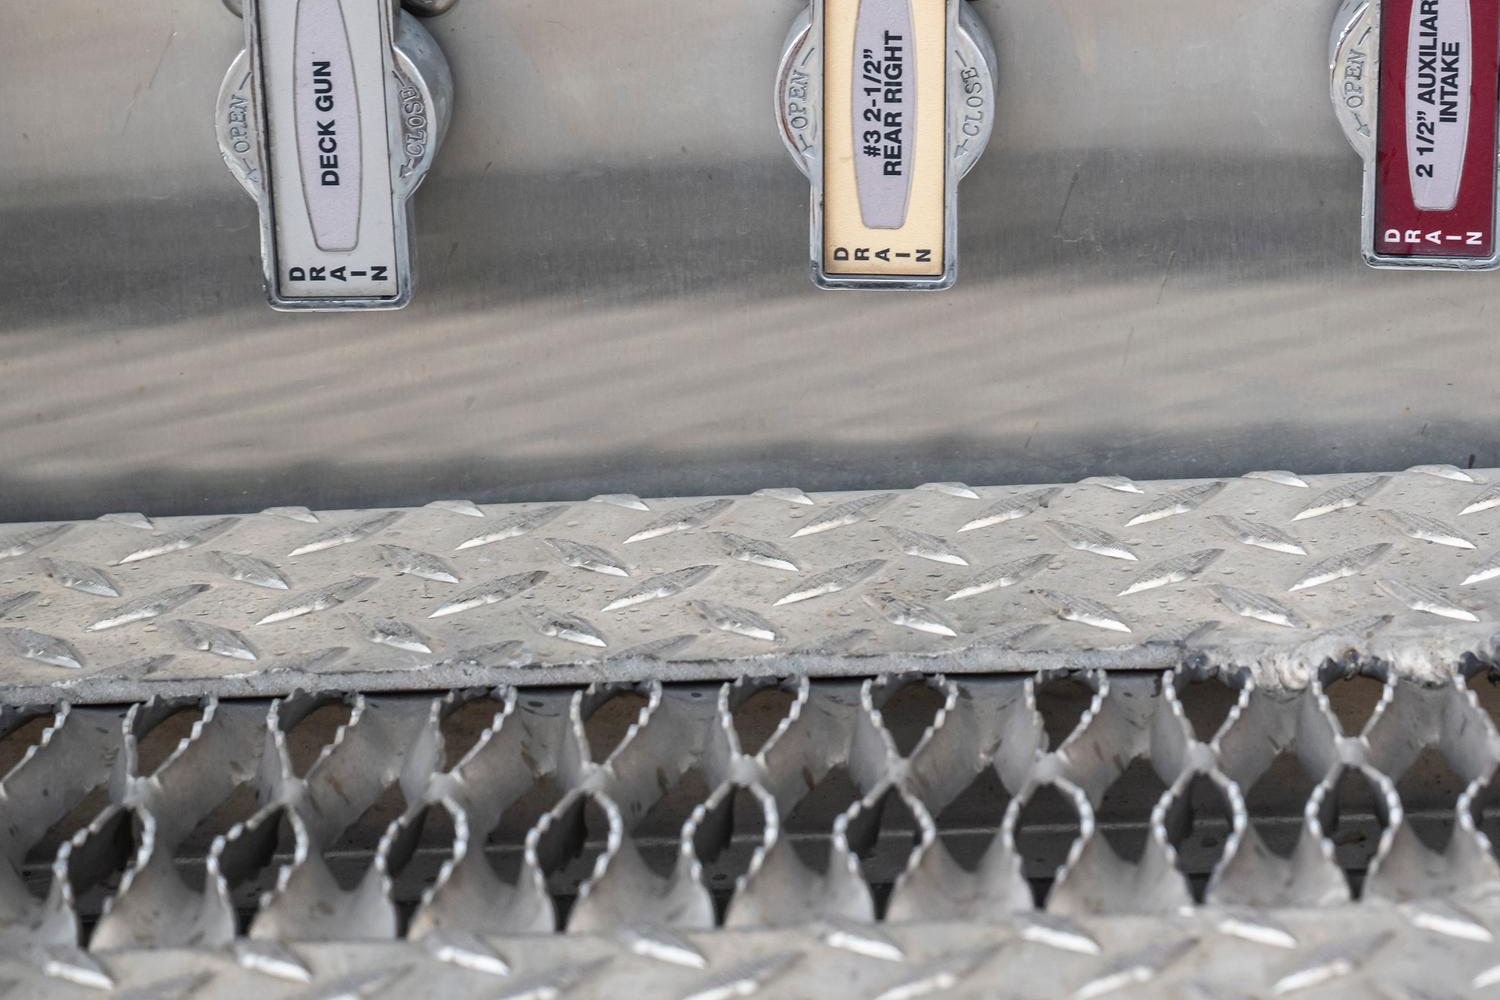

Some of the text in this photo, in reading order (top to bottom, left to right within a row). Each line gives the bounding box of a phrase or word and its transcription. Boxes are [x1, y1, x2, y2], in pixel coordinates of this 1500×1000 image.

[789, 69, 810, 130] OPEN
[883, 31, 903, 176] REAR RIGHT
[960, 66, 984, 137] CLOSE
[1344, 48, 1368, 109] OPEN
[1439, 42, 1460, 123] INTAKE
[231, 94, 250, 153] OPEN
[312, 61, 340, 186] DECK GUN
[400, 85, 426, 155] CLOSE
[863, 129, 881, 157] #3
[1416, 164, 1433, 178] 2
[833, 247, 932, 262] DRAIN
[1384, 229, 1482, 244] DRAIN
[289, 266, 388, 282] DRAIN
